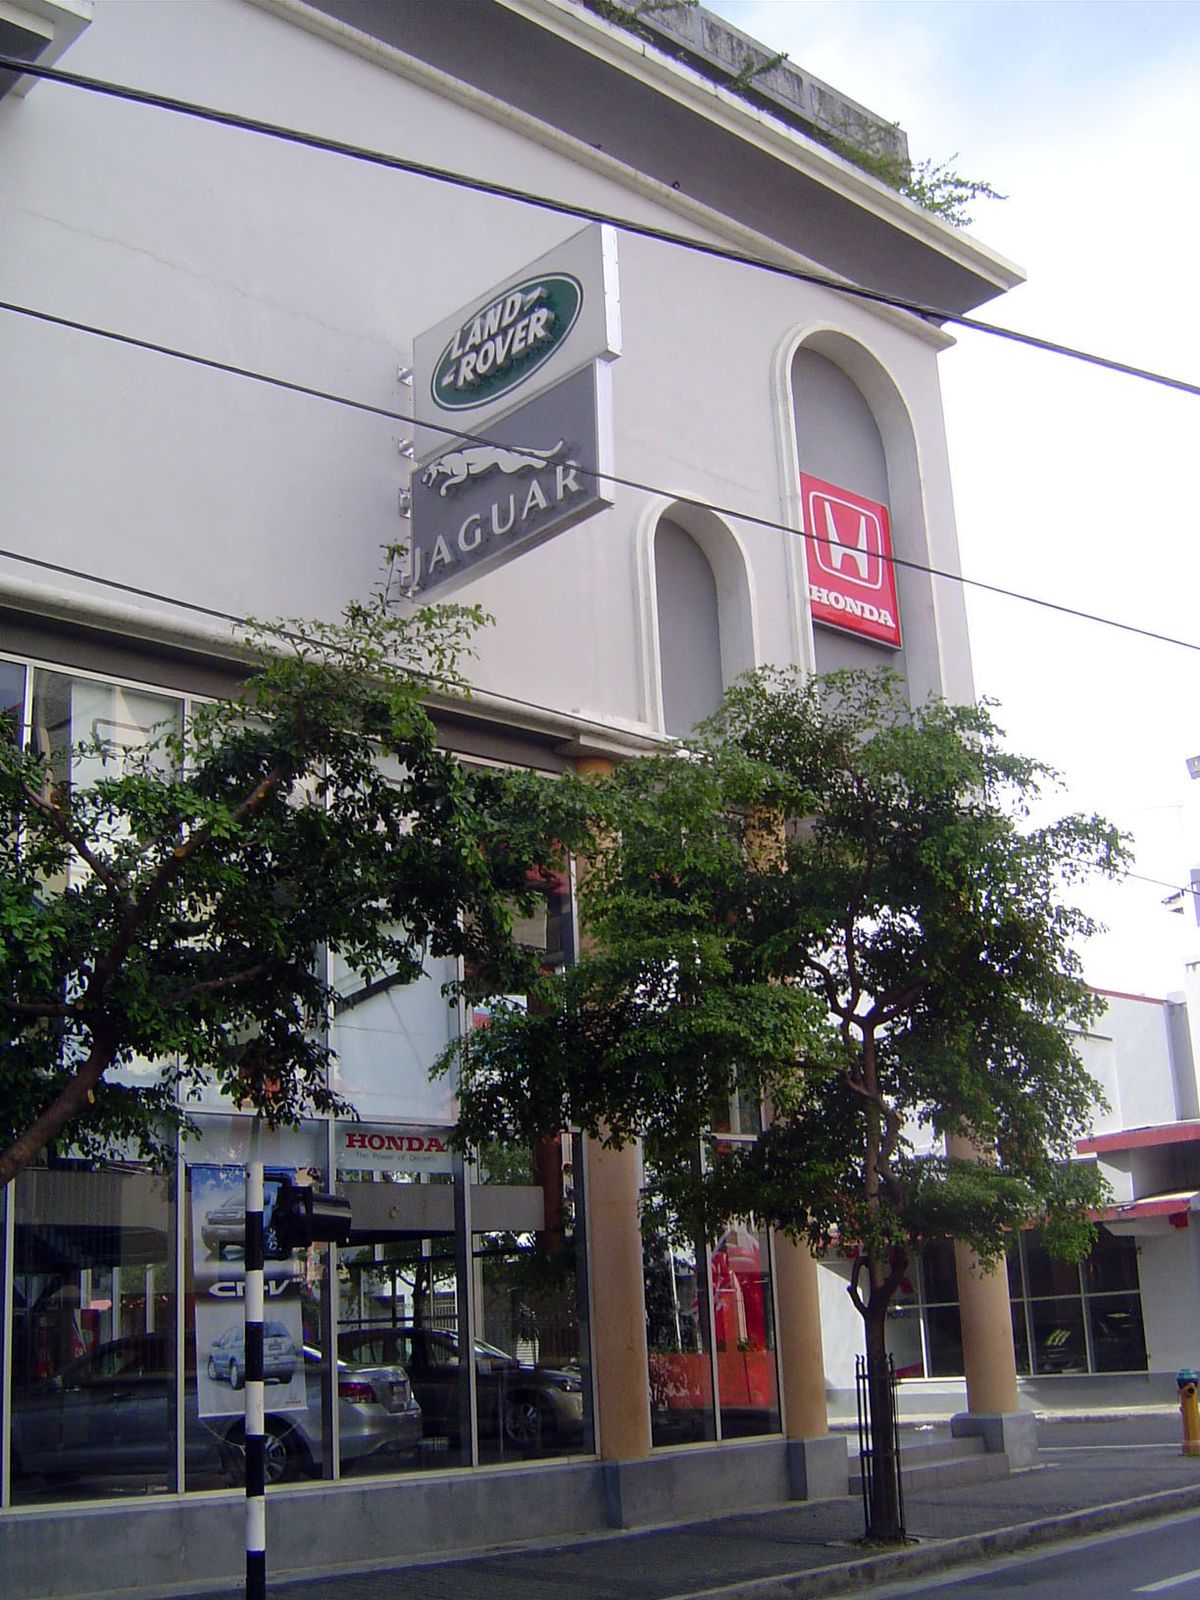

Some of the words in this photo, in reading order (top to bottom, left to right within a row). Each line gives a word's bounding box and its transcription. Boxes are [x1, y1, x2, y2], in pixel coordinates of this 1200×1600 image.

[450, 293, 524, 360] LAND
[456, 308, 552, 387] ROVER
[411, 460, 582, 590] JAGUAR
[809, 585, 896, 628] HONDA
[345, 1132, 446, 1152] HONDA
